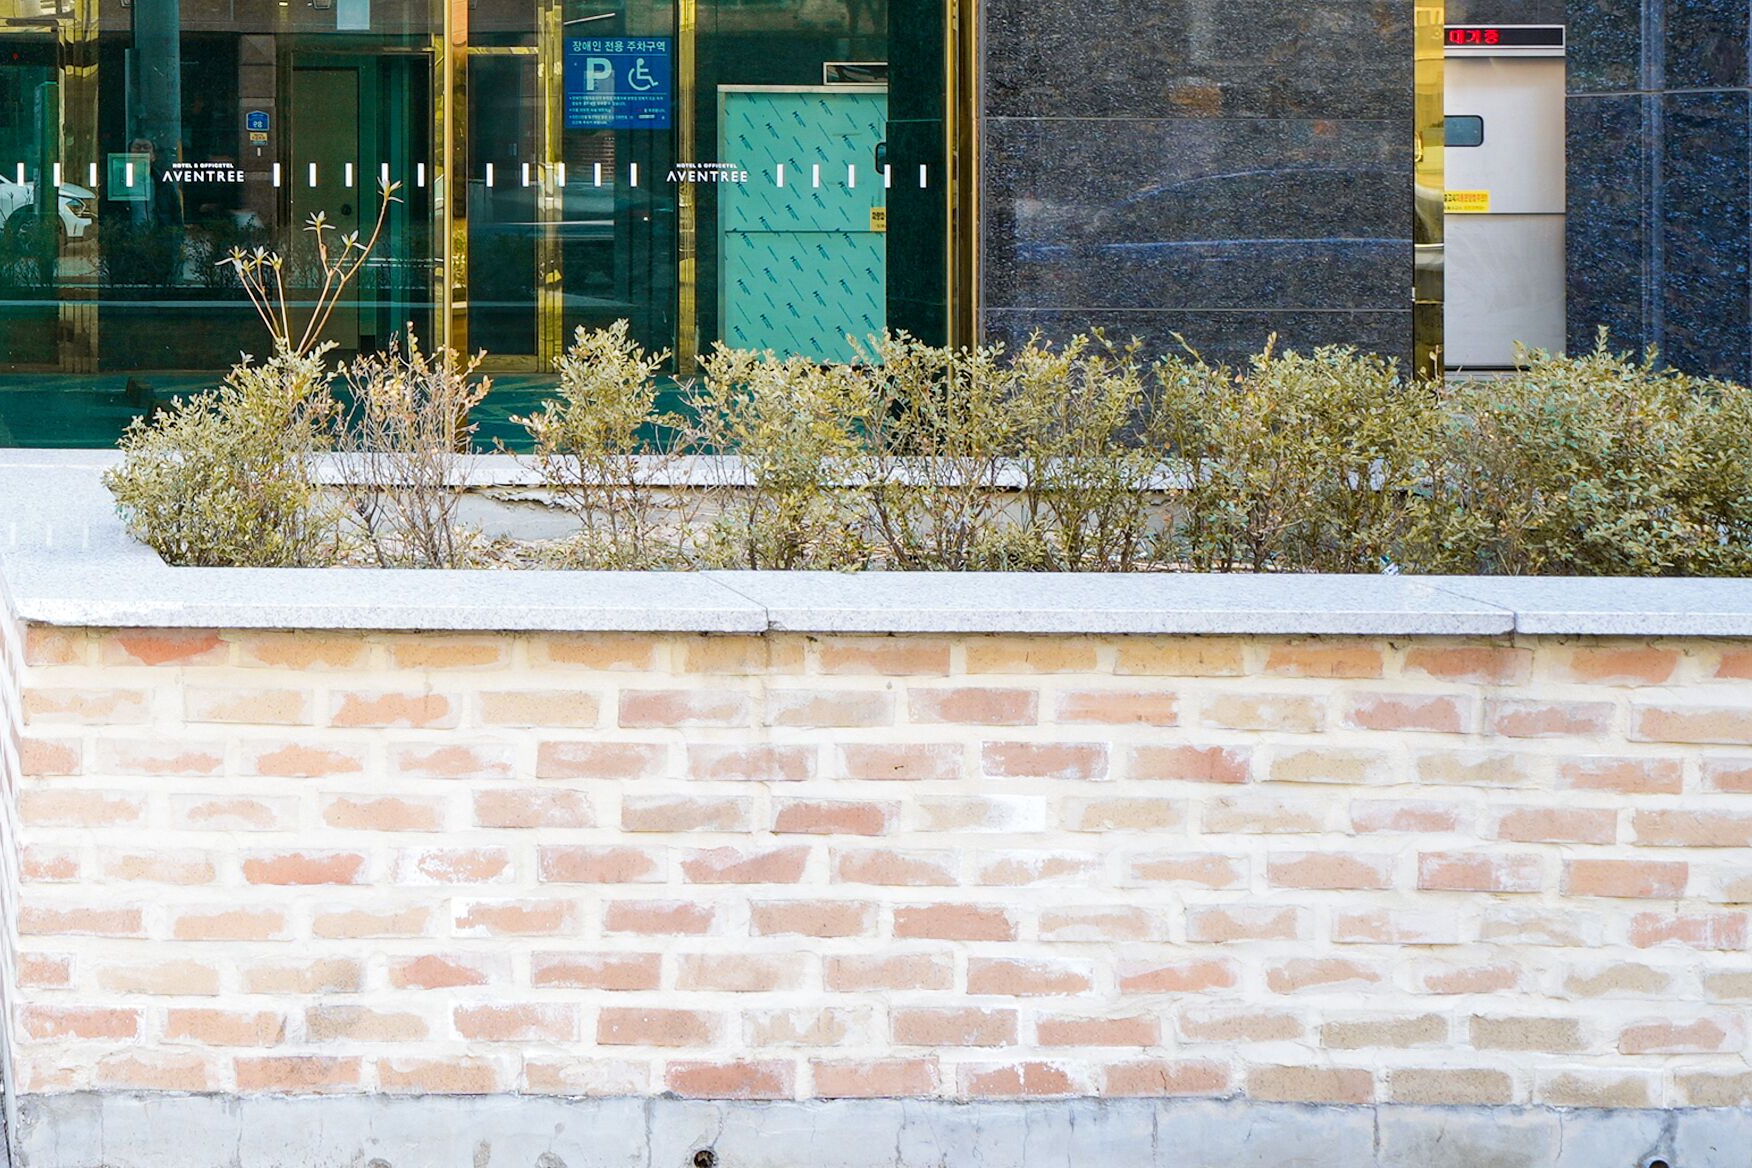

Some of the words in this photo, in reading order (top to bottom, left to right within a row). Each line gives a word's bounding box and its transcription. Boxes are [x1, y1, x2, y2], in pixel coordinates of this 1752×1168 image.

[572, 40, 602, 52] 장애인
[604, 40, 624, 52] 전용
[627, 40, 666, 52] 주차구역
[586, 57, 612, 91] P
[162, 171, 245, 181] AVENTREE
[666, 171, 748, 182] AVENTREE
